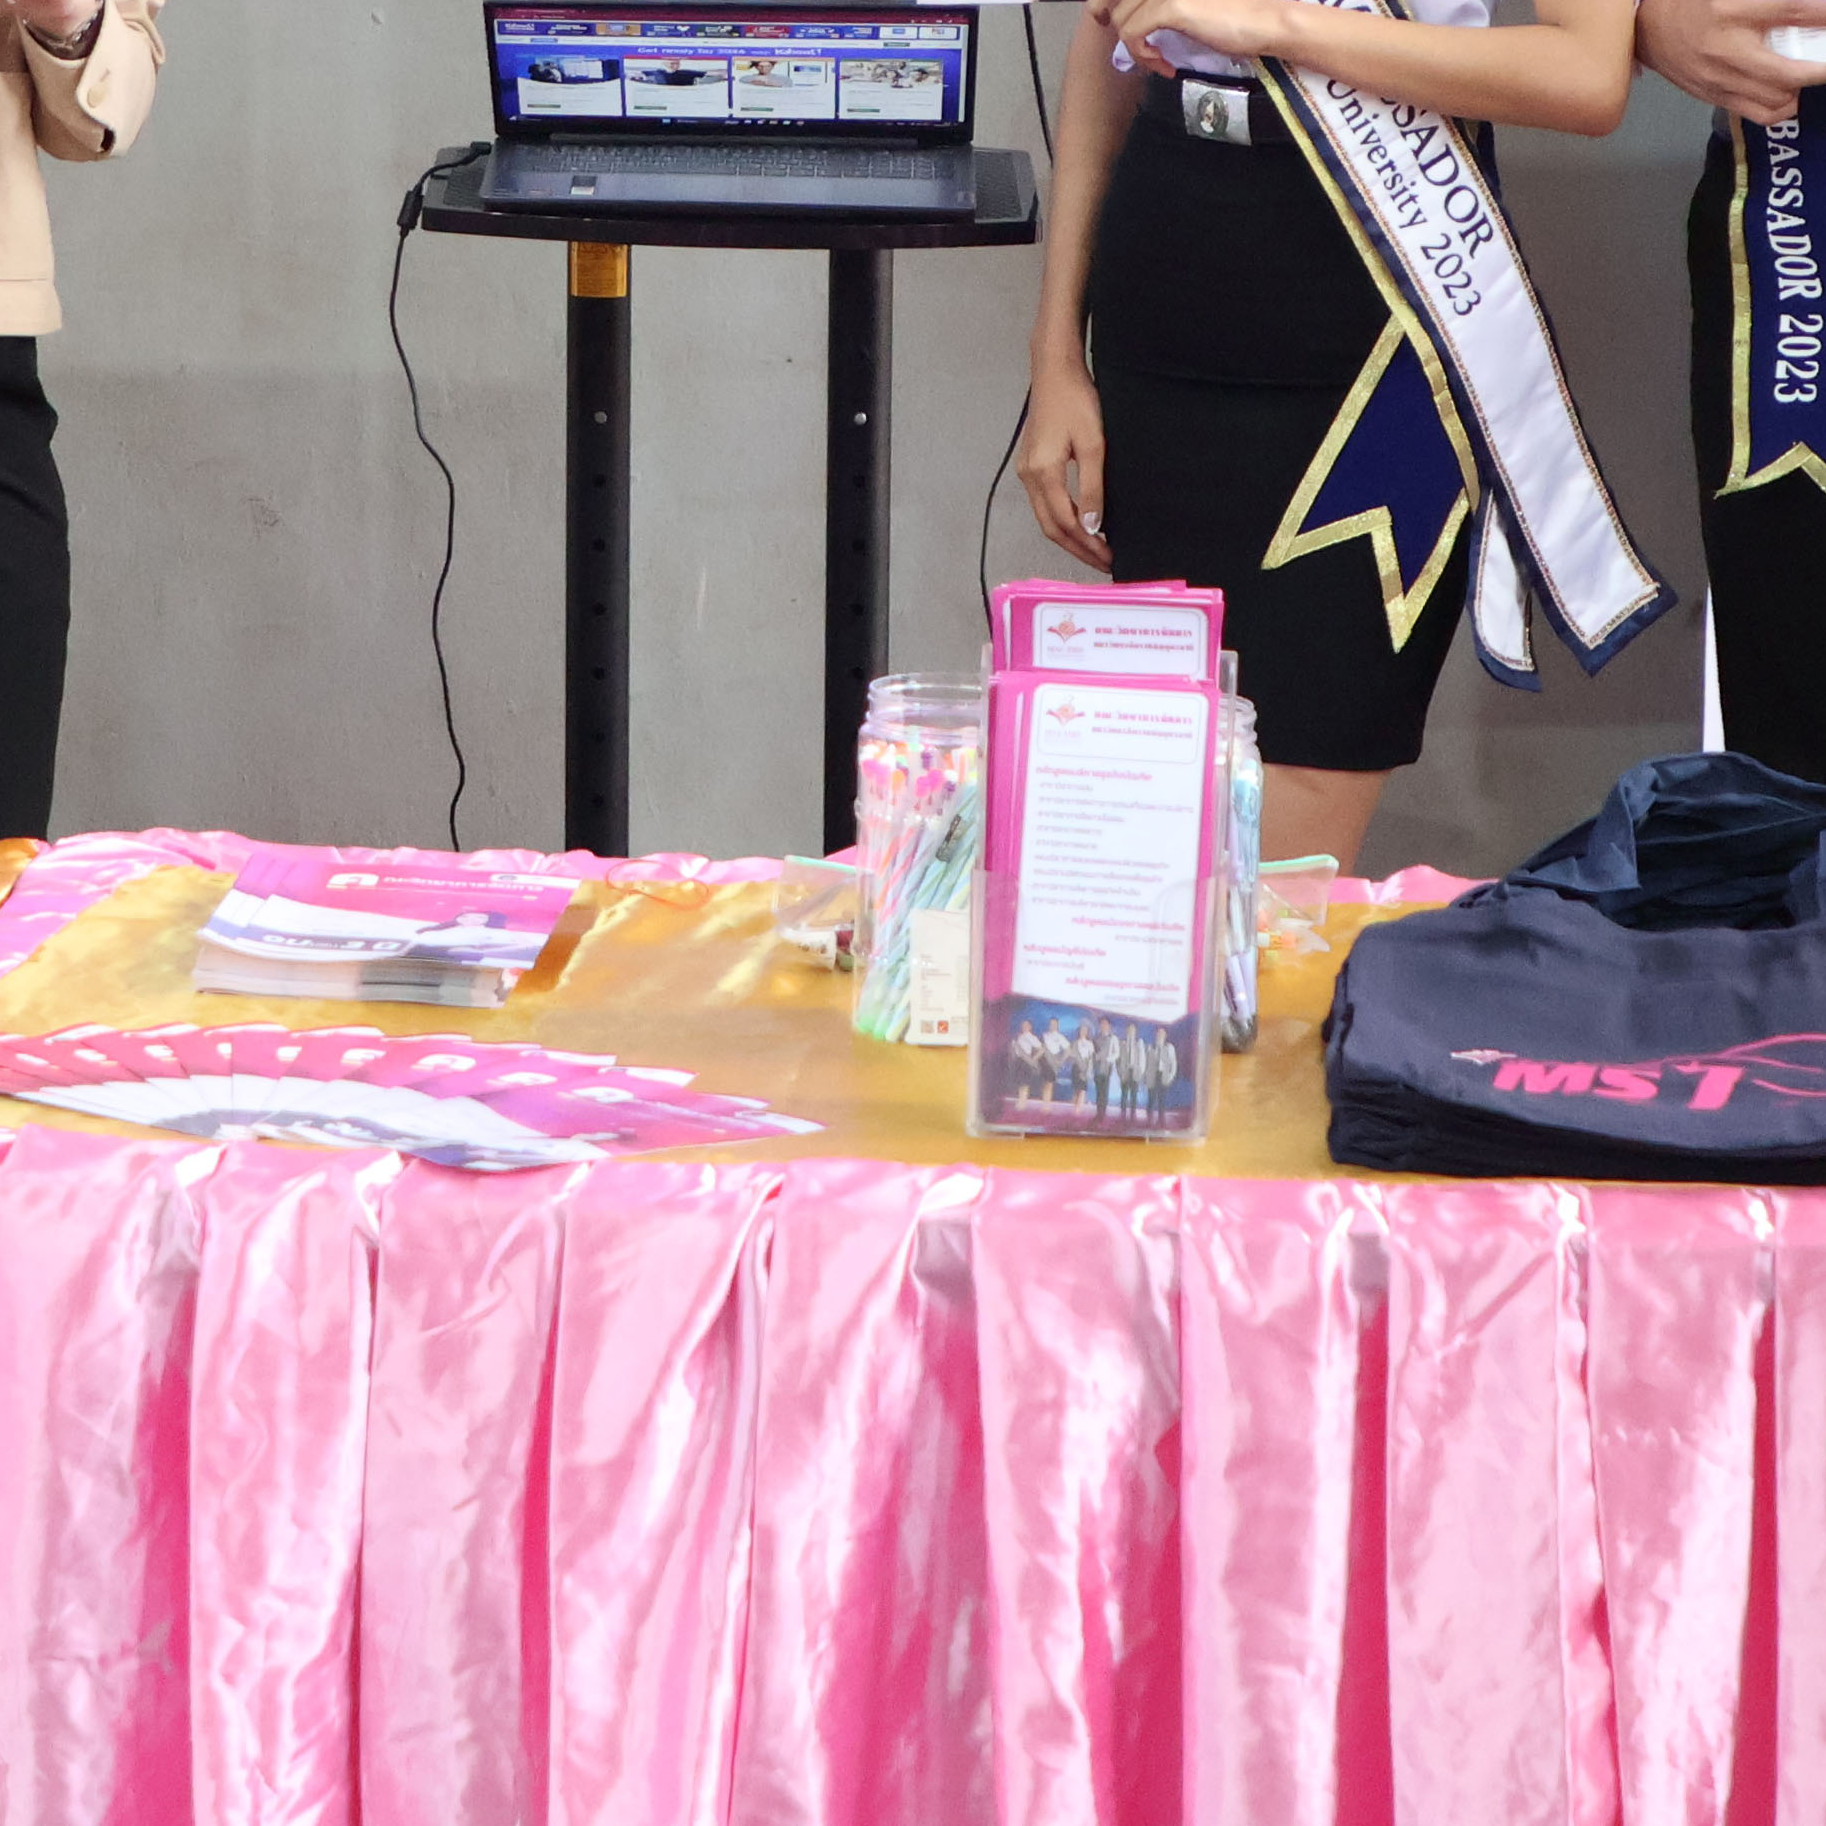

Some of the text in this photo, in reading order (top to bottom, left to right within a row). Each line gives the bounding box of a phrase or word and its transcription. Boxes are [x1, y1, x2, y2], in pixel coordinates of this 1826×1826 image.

[1420, 232, 1482, 317] 2023
[1773, 313, 1824, 405] 2023
[1492, 1060, 1663, 1101] MS
